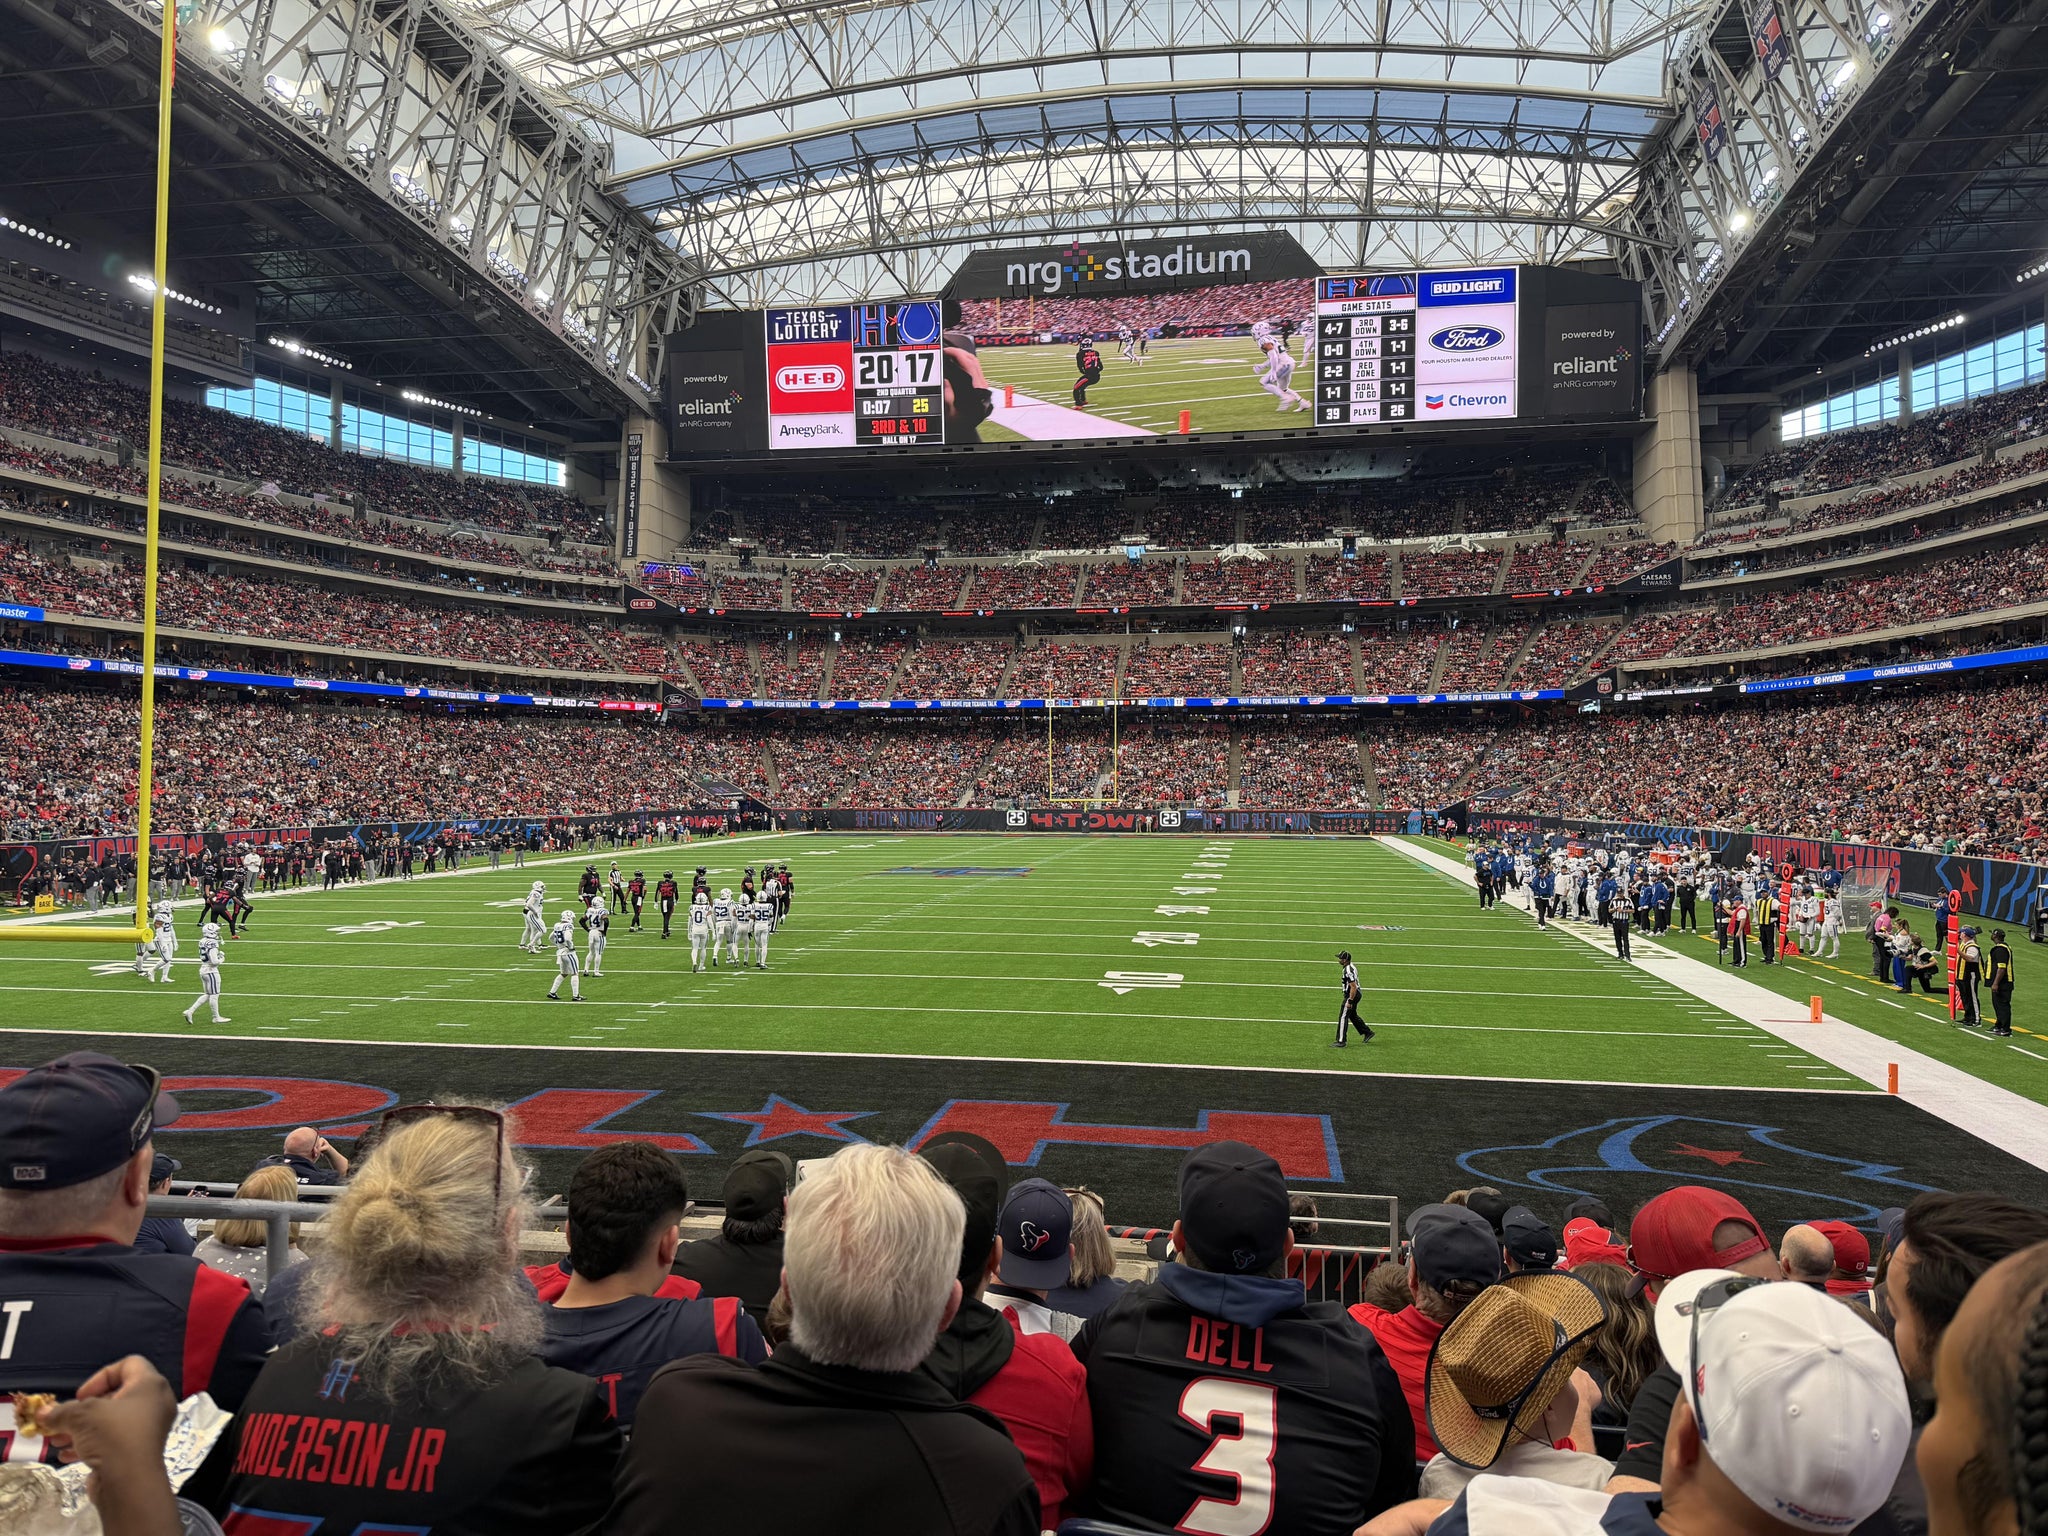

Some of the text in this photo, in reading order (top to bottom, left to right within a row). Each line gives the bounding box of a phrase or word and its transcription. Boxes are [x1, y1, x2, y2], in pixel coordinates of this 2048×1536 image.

[1006, 244, 1251, 293] nrg stadium
[1433, 280, 1502, 294] BUD LIGHT
[1341, 300, 1392, 312] GAME STATS
[786, 310, 826, 324] TEXAS
[1358, 318, 1374, 327] 3RD
[775, 319, 839, 341] LOTTERY
[1324, 322, 1344, 335] 4-7
[1355, 326, 1377, 335] DOWN
[1389, 319, 1408, 331] 3-6
[1443, 328, 1490, 348] Ford
[1561, 328, 1615, 341] powered by
[1324, 343, 1343, 357] 0-0
[1358, 340, 1374, 348] 4TH
[1390, 340, 1406, 353] 1-1
[1355, 348, 1377, 357] DOWN
[859, 354, 893, 385] 20
[905, 353, 935, 383] 17
[1324, 365, 1343, 378] 2-2
[1358, 361, 1373, 370] RED
[1390, 361, 1406, 374] 1-1
[1553, 356, 1618, 375] reliant
[683, 374, 729, 385] powered by
[1356, 369, 1376, 378] ZONE
[1356, 383, 1375, 391] GOAL
[1390, 382, 1406, 395] 1-1
[1563, 380, 1581, 388] NRG
[1582, 380, 1617, 388] company
[877, 387, 917, 397] 2ND QUARTER
[1325, 386, 1341, 399] 1-1
[1354, 390, 1376, 399] TO GO
[678, 398, 732, 415] reliant
[912, 398, 929, 413] 25
[1449, 394, 1507, 407] Chevron
[862, 400, 891, 415] 0:07
[1326, 407, 1340, 420] 39
[1353, 407, 1377, 417] PLAYS
[1390, 404, 1405, 417] 26
[703, 420, 732, 428] company
[871, 418, 927, 434] 3RD & 10
[882, 435, 917, 445] BALL ON 17
[1640, 573, 1672, 581] CAESARS
[104, 661, 119, 671] YOUR
[120, 663, 135, 673] HOME
[167, 668, 179, 677] TALK
[1459, 693, 1472, 701] HOME
[1472, 693, 1482, 701] FOR
[1482, 692, 1500, 700] TEXANS
[1501, 692, 1512, 700] TALK
[1009, 812, 1024, 824] 25
[1162, 813, 1179, 825] 25
[1831, 844, 1901, 896] TEXANS
[38, 900, 51, 908] BASE
[1186, 1315, 1273, 1372] DELL
[232, 1412, 447, 1493] ANDERSON JR
[1175, 1375, 1279, 1536] 3
